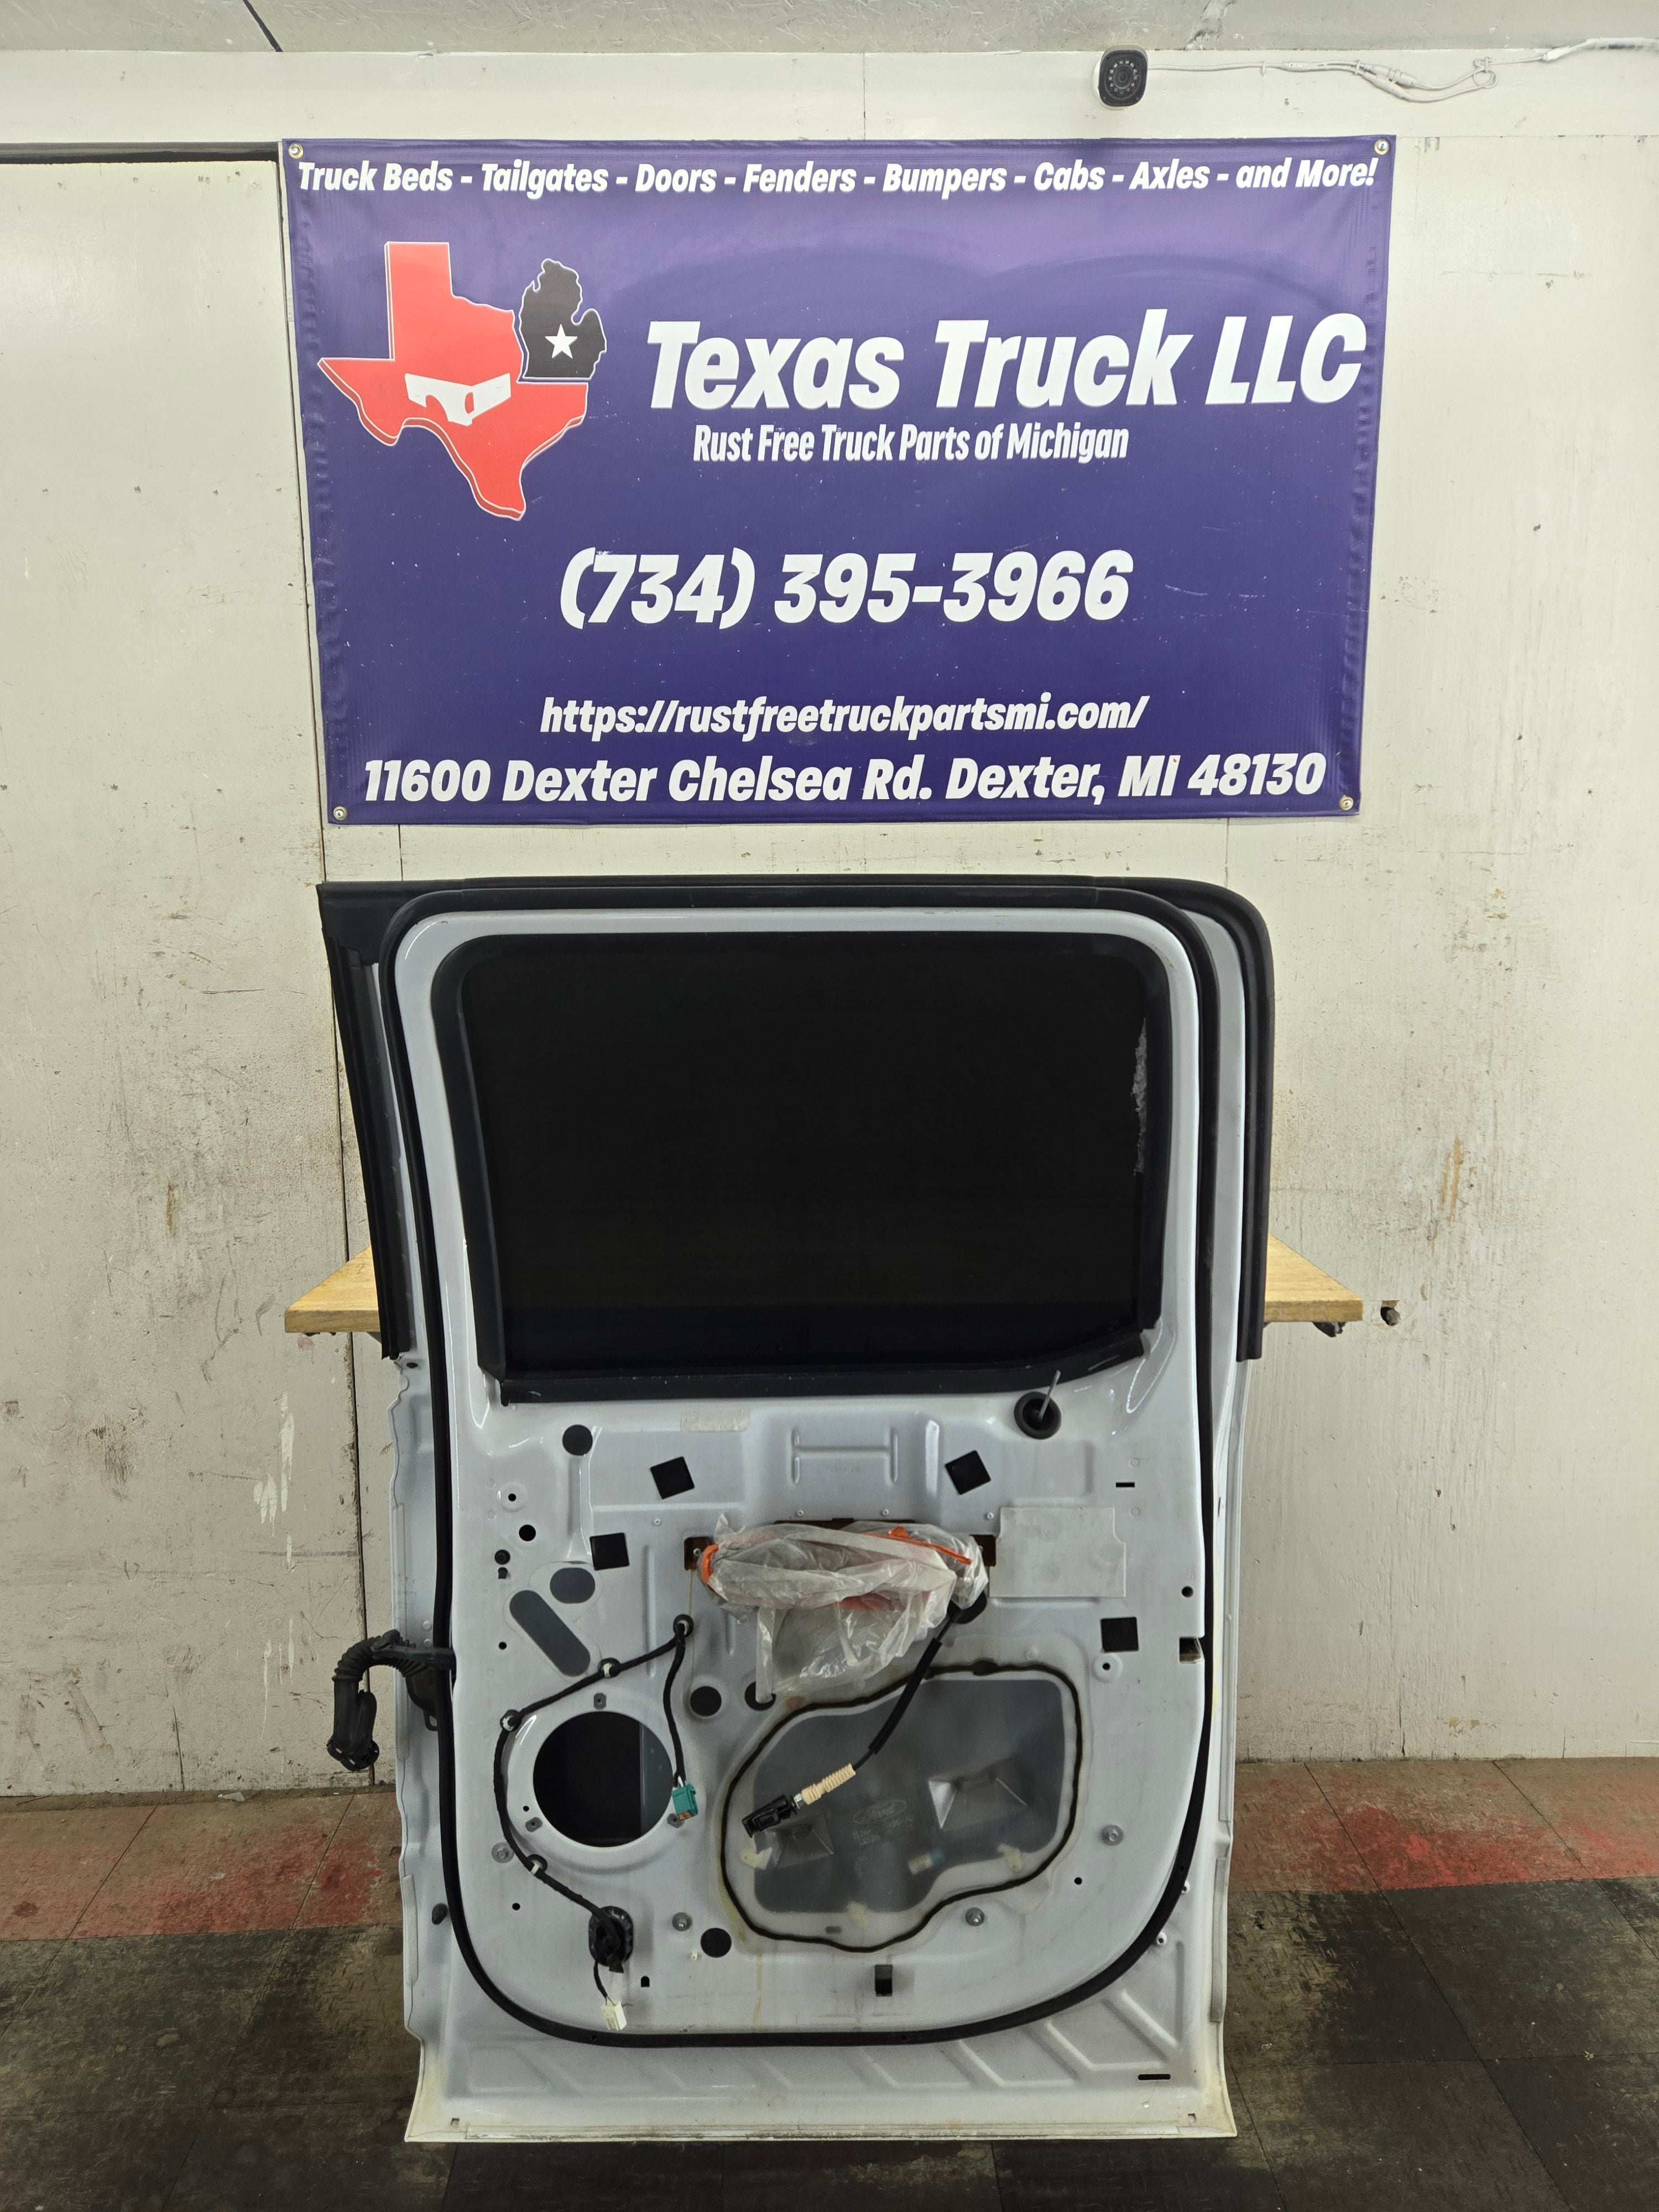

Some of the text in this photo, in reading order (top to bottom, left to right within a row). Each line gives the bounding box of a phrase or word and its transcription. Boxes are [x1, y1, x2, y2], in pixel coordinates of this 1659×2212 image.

[298, 159, 379, 192] Truck
[382, 159, 454, 192] Beds
[481, 158, 609, 201] Tailgates
[634, 163, 718, 194] Doors
[742, 160, 858, 194] Fenders
[881, 163, 1008, 201] Bumpers
[1033, 158, 1106, 192] Cabs
[1128, 157, 1211, 191] Axles
[1235, 157, 1291, 189] and
[1294, 156, 1380, 189] More!
[646, 308, 1368, 410] Texas Truck LLC
[692, 421, 1130, 465] Rust Free Truck Parts of Michigan
[560, 546, 1134, 630] (734) 395-3966
[539, 691, 1151, 743] https://rustfreetruckpartsmi.com/
[364, 752, 1327, 806] 11600 Dexter Chelsea Rd. Dexter, MI 48130
